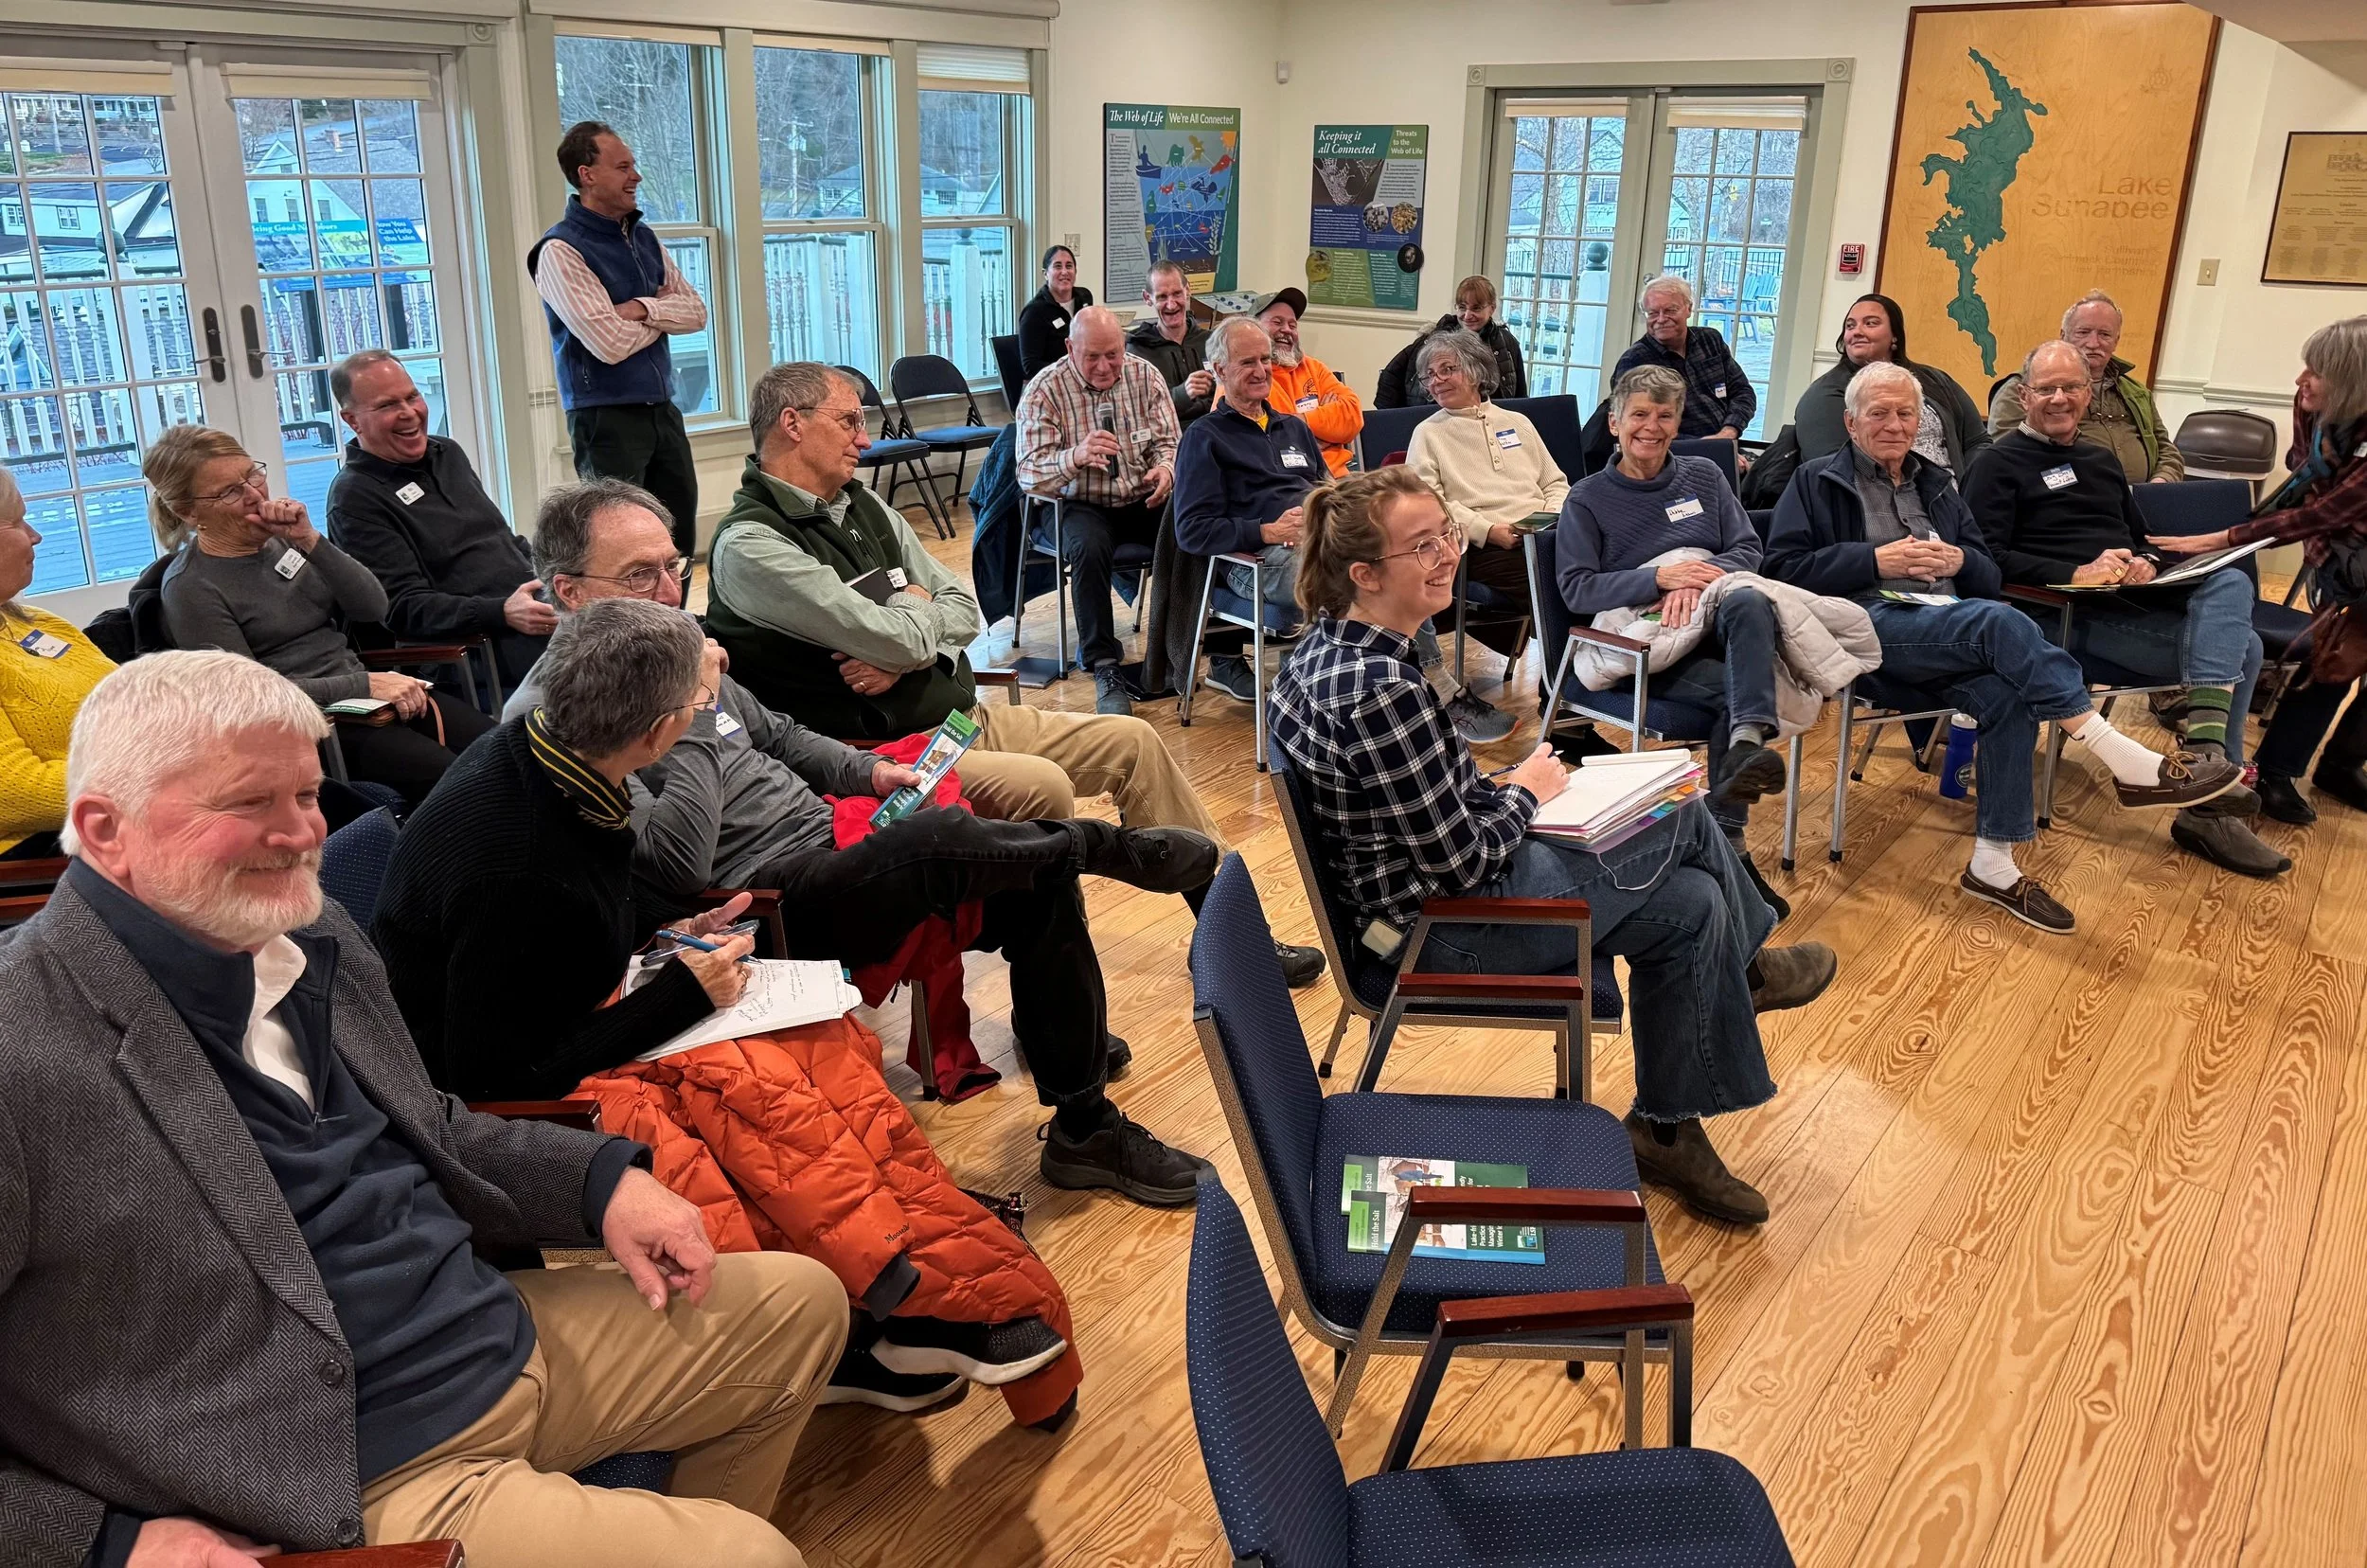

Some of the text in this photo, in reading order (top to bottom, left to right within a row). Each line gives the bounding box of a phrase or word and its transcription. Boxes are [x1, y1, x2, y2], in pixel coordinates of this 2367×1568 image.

[1110, 110, 1164, 126] The Web of Life
[1168, 112, 1235, 125] We're All Connected
[1319, 130, 1362, 144] Keeping it
[1318, 142, 1377, 154] all Connected
[2097, 172, 2172, 196] Lake
[274, 223, 296, 232] Good
[1372, 1210, 1380, 1221] Salt
[1371, 1233, 1379, 1248] Hold
